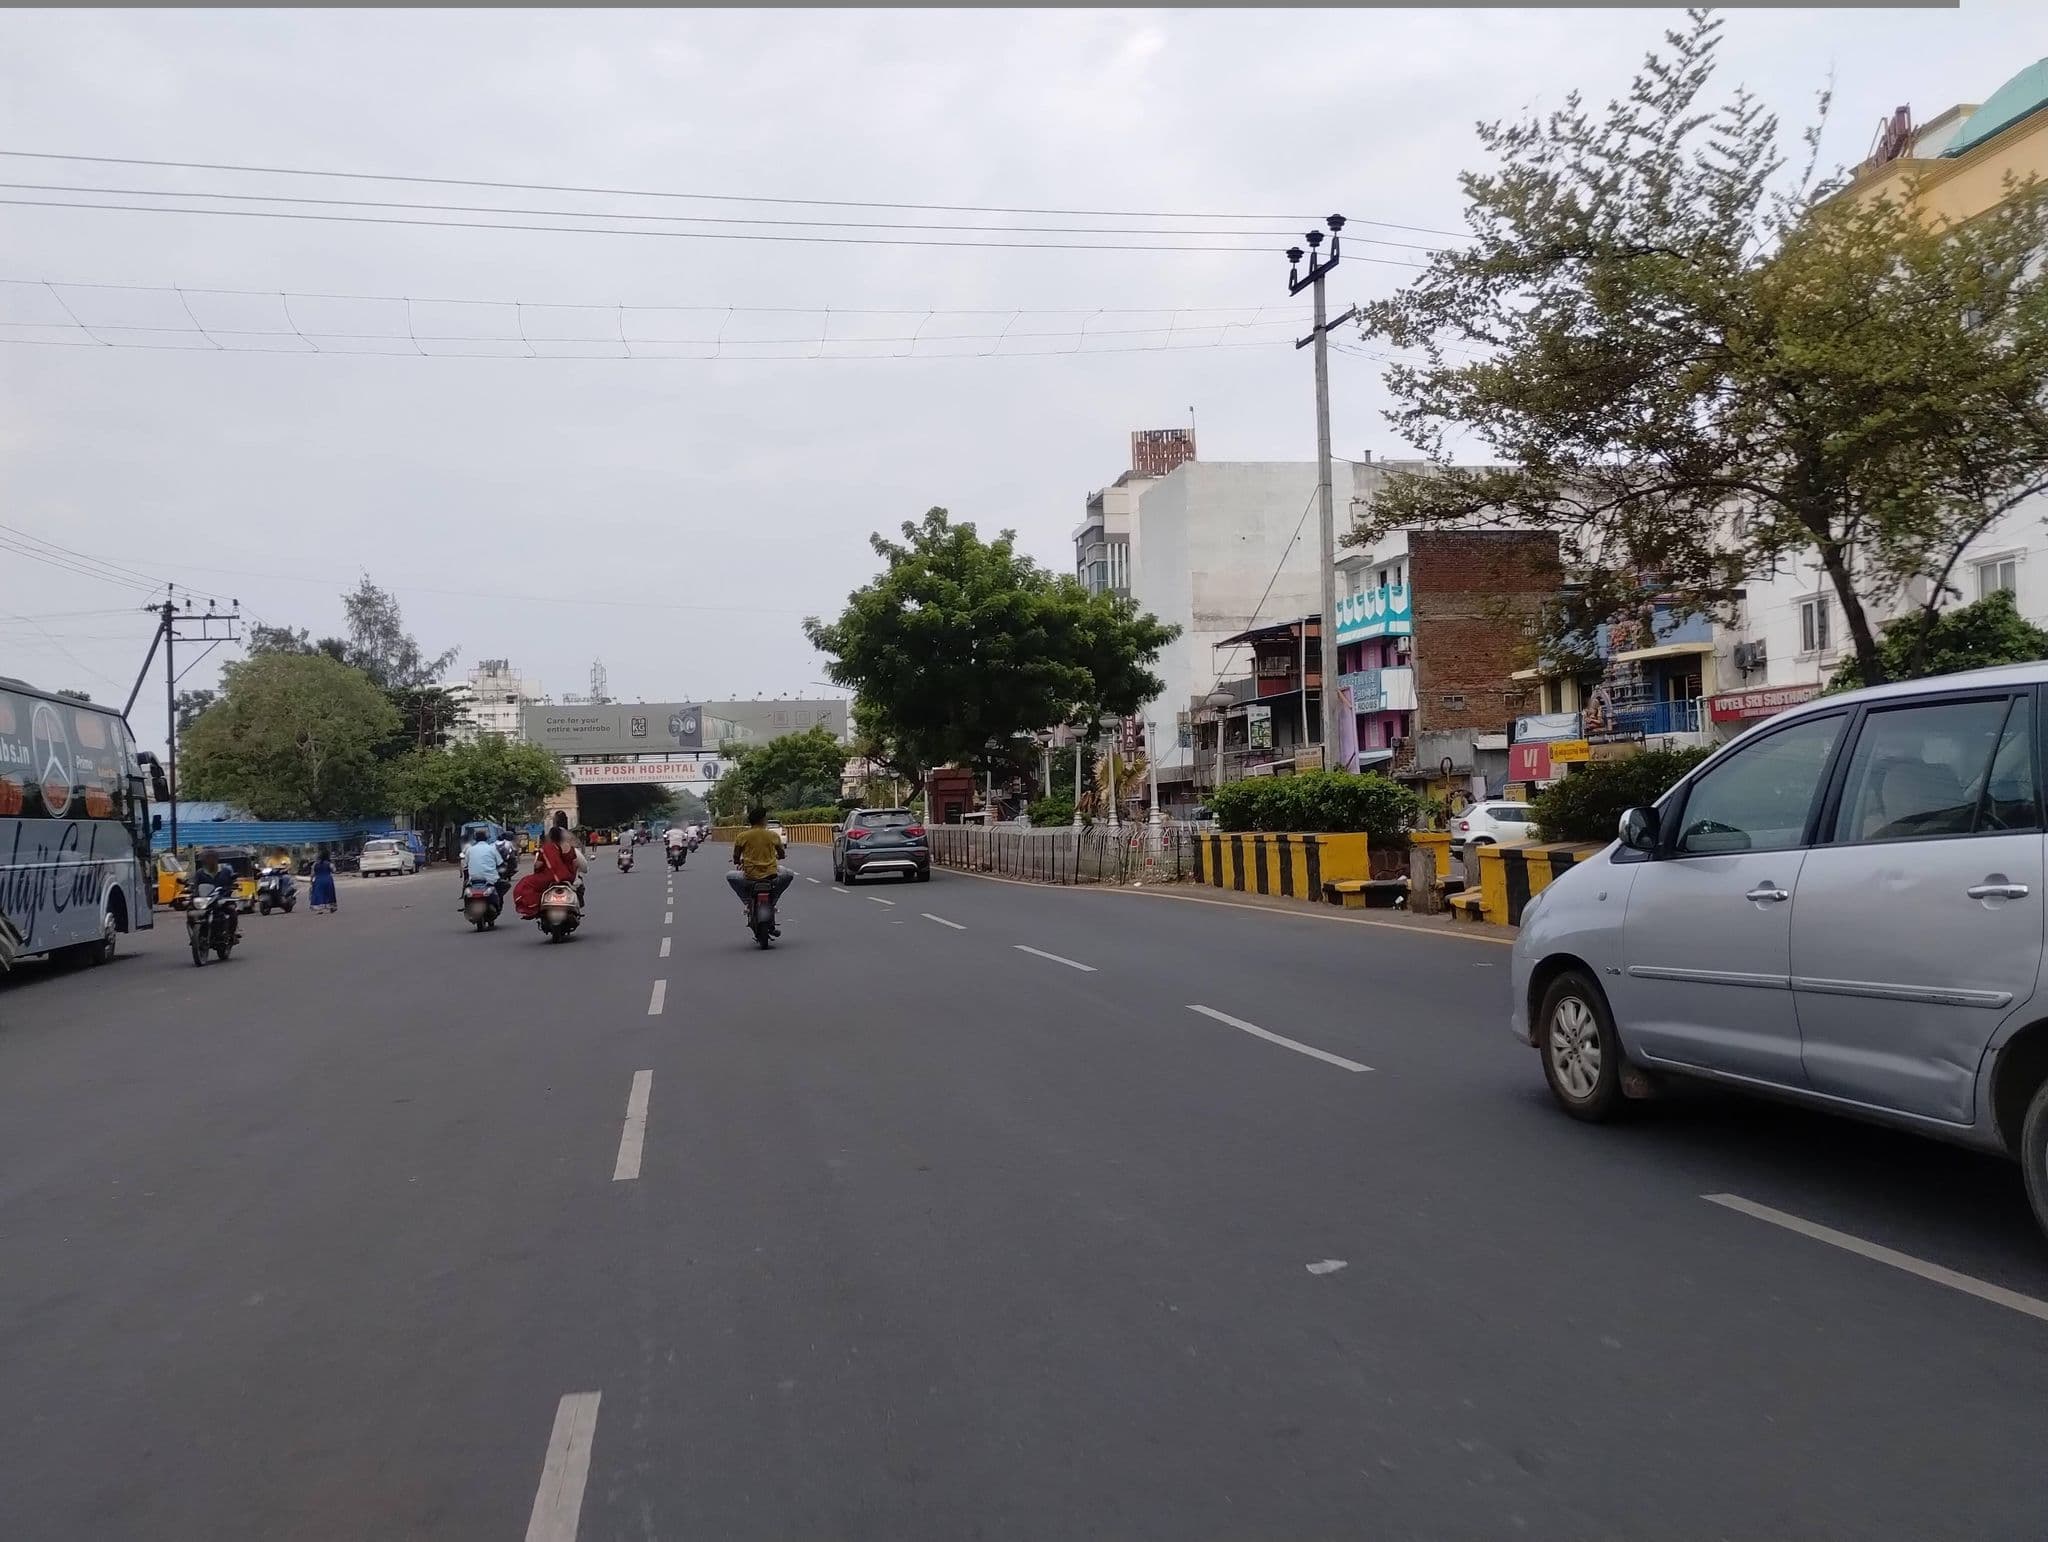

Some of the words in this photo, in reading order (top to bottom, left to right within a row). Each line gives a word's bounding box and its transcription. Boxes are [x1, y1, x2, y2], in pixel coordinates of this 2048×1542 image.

[1144, 429, 1187, 442] HOTEL
[1715, 697, 1745, 711] HOTEL
[1746, 695, 1763, 708] SRI
[546, 717, 566, 725] Care
[567, 717, 578, 725] for
[581, 717, 599, 725] your
[572, 725, 611, 733] wardrobe
[0, 736, 30, 766] bs.in
[578, 767, 600, 776] THE
[604, 766, 635, 775] POSH
[639, 764, 696, 774] HOSPITAL
